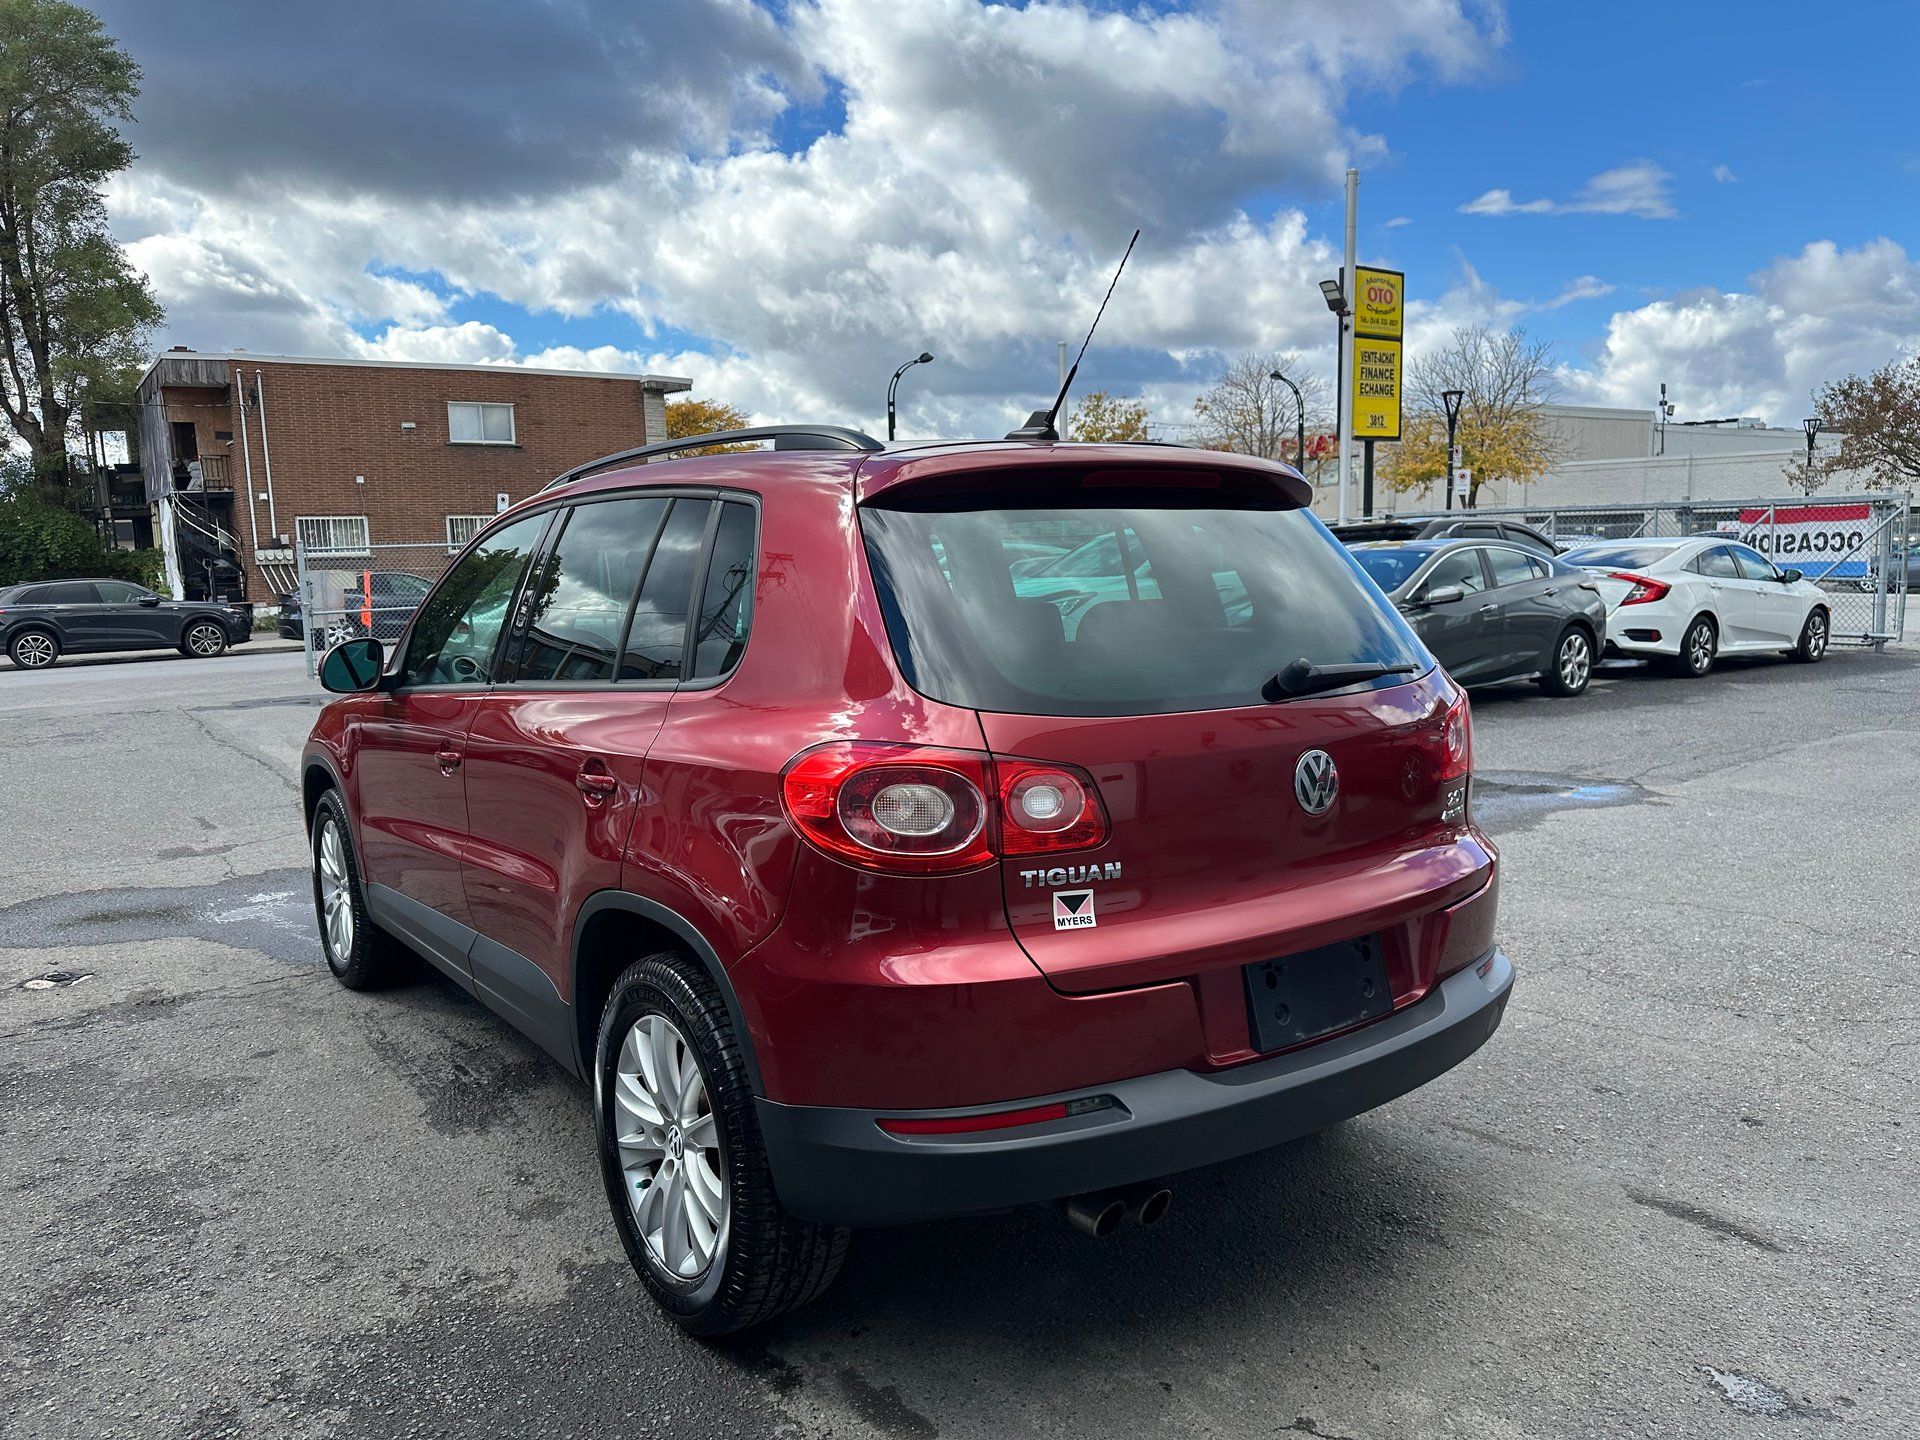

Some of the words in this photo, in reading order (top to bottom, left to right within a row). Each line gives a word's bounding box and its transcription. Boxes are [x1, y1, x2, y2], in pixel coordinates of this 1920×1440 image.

[1367, 287, 1394, 304] OTO
[1360, 350, 1395, 364] VENTE-ACHAT
[1360, 366, 1394, 380] FINANCE
[1360, 382, 1394, 396] ECHANGE
[1370, 414, 1384, 427] 3812
[1020, 861, 1121, 888] TIGUAN
[1057, 915, 1093, 927] MYERS
